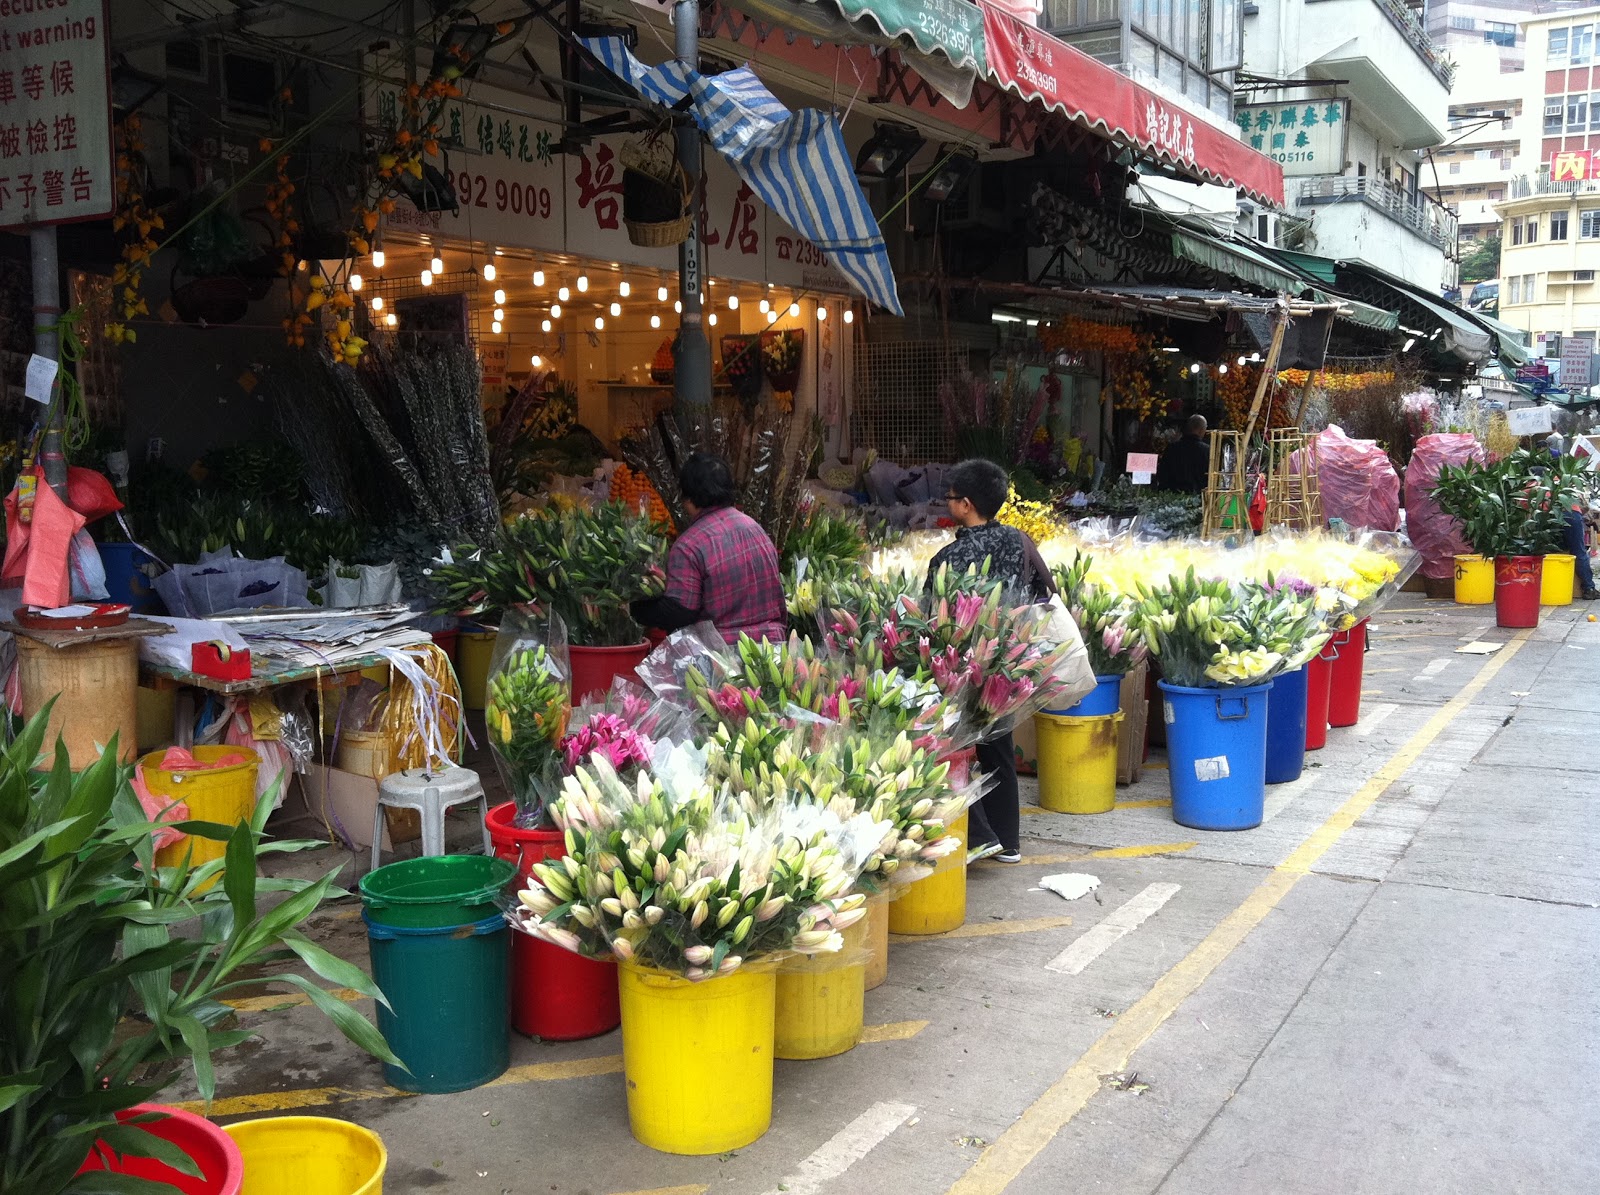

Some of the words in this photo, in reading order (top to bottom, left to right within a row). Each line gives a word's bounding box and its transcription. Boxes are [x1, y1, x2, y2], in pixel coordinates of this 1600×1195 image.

[17, 17, 95, 49] warning
[919, 12, 974, 57] 23263961
[0, 60, 75, 105] 車等候
[1016, 60, 1057, 94] 23263961
[0, 113, 77, 159] 被檢控
[1146, 100, 1195, 162] 培記花店
[1266, 151, 1314, 163] 805116
[495, 179, 551, 219] 9009
[687, 249, 696, 291] 1079
